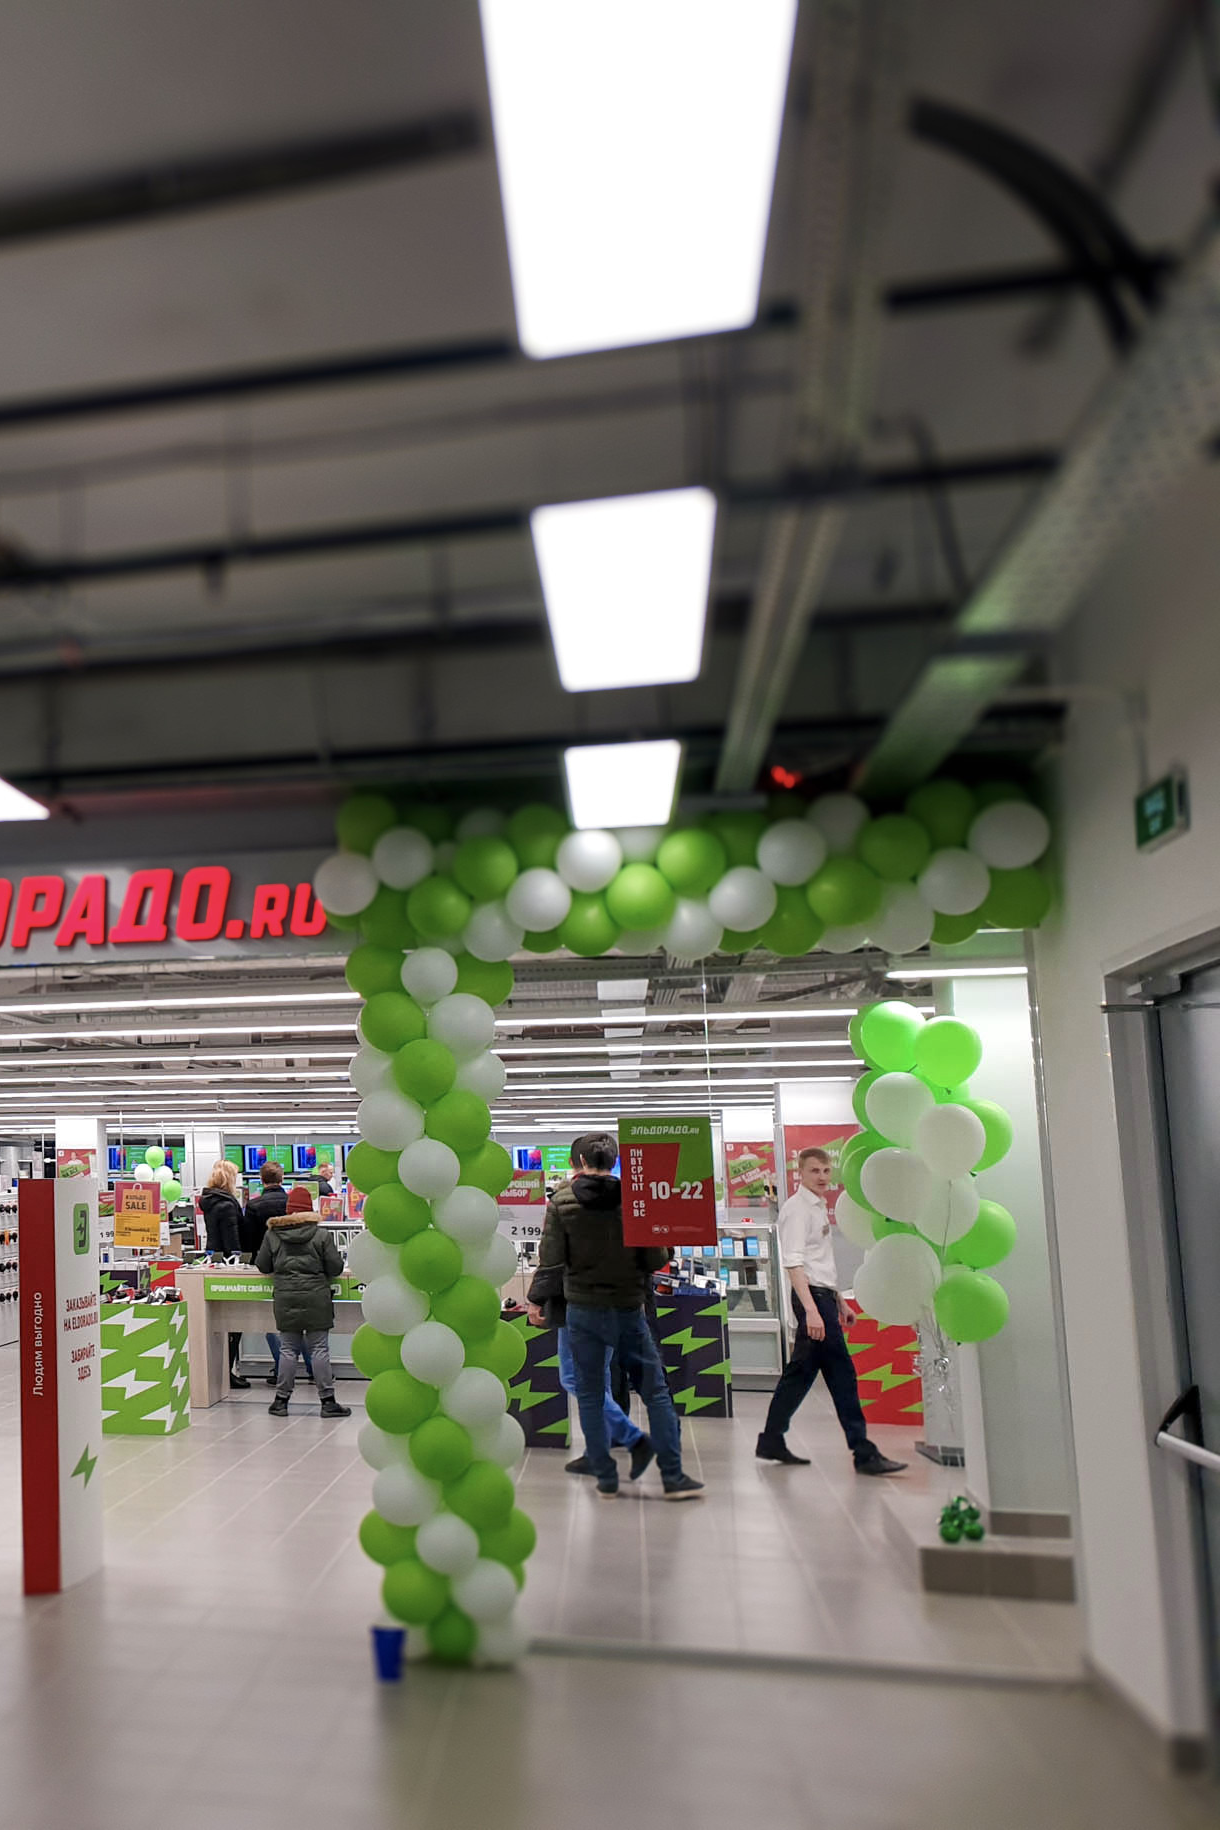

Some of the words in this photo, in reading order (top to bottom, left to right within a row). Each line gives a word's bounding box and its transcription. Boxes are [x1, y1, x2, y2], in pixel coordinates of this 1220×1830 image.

[630, 1148, 643, 1157] ПН
[630, 1157, 643, 1166] ВТ
[631, 1166, 644, 1174] СР
[631, 1174, 644, 1183] ЧТ
[632, 1182, 644, 1191] ПТ
[649, 1181, 704, 1200] 10-22
[125, 1201, 147, 1210] SALE
[633, 1200, 646, 1208] СБ
[633, 1208, 646, 1217] ВС
[34, 1292, 44, 1347] выгодно
[63, 1318, 71, 1332] НА
[32, 1350, 45, 1396] Людям
